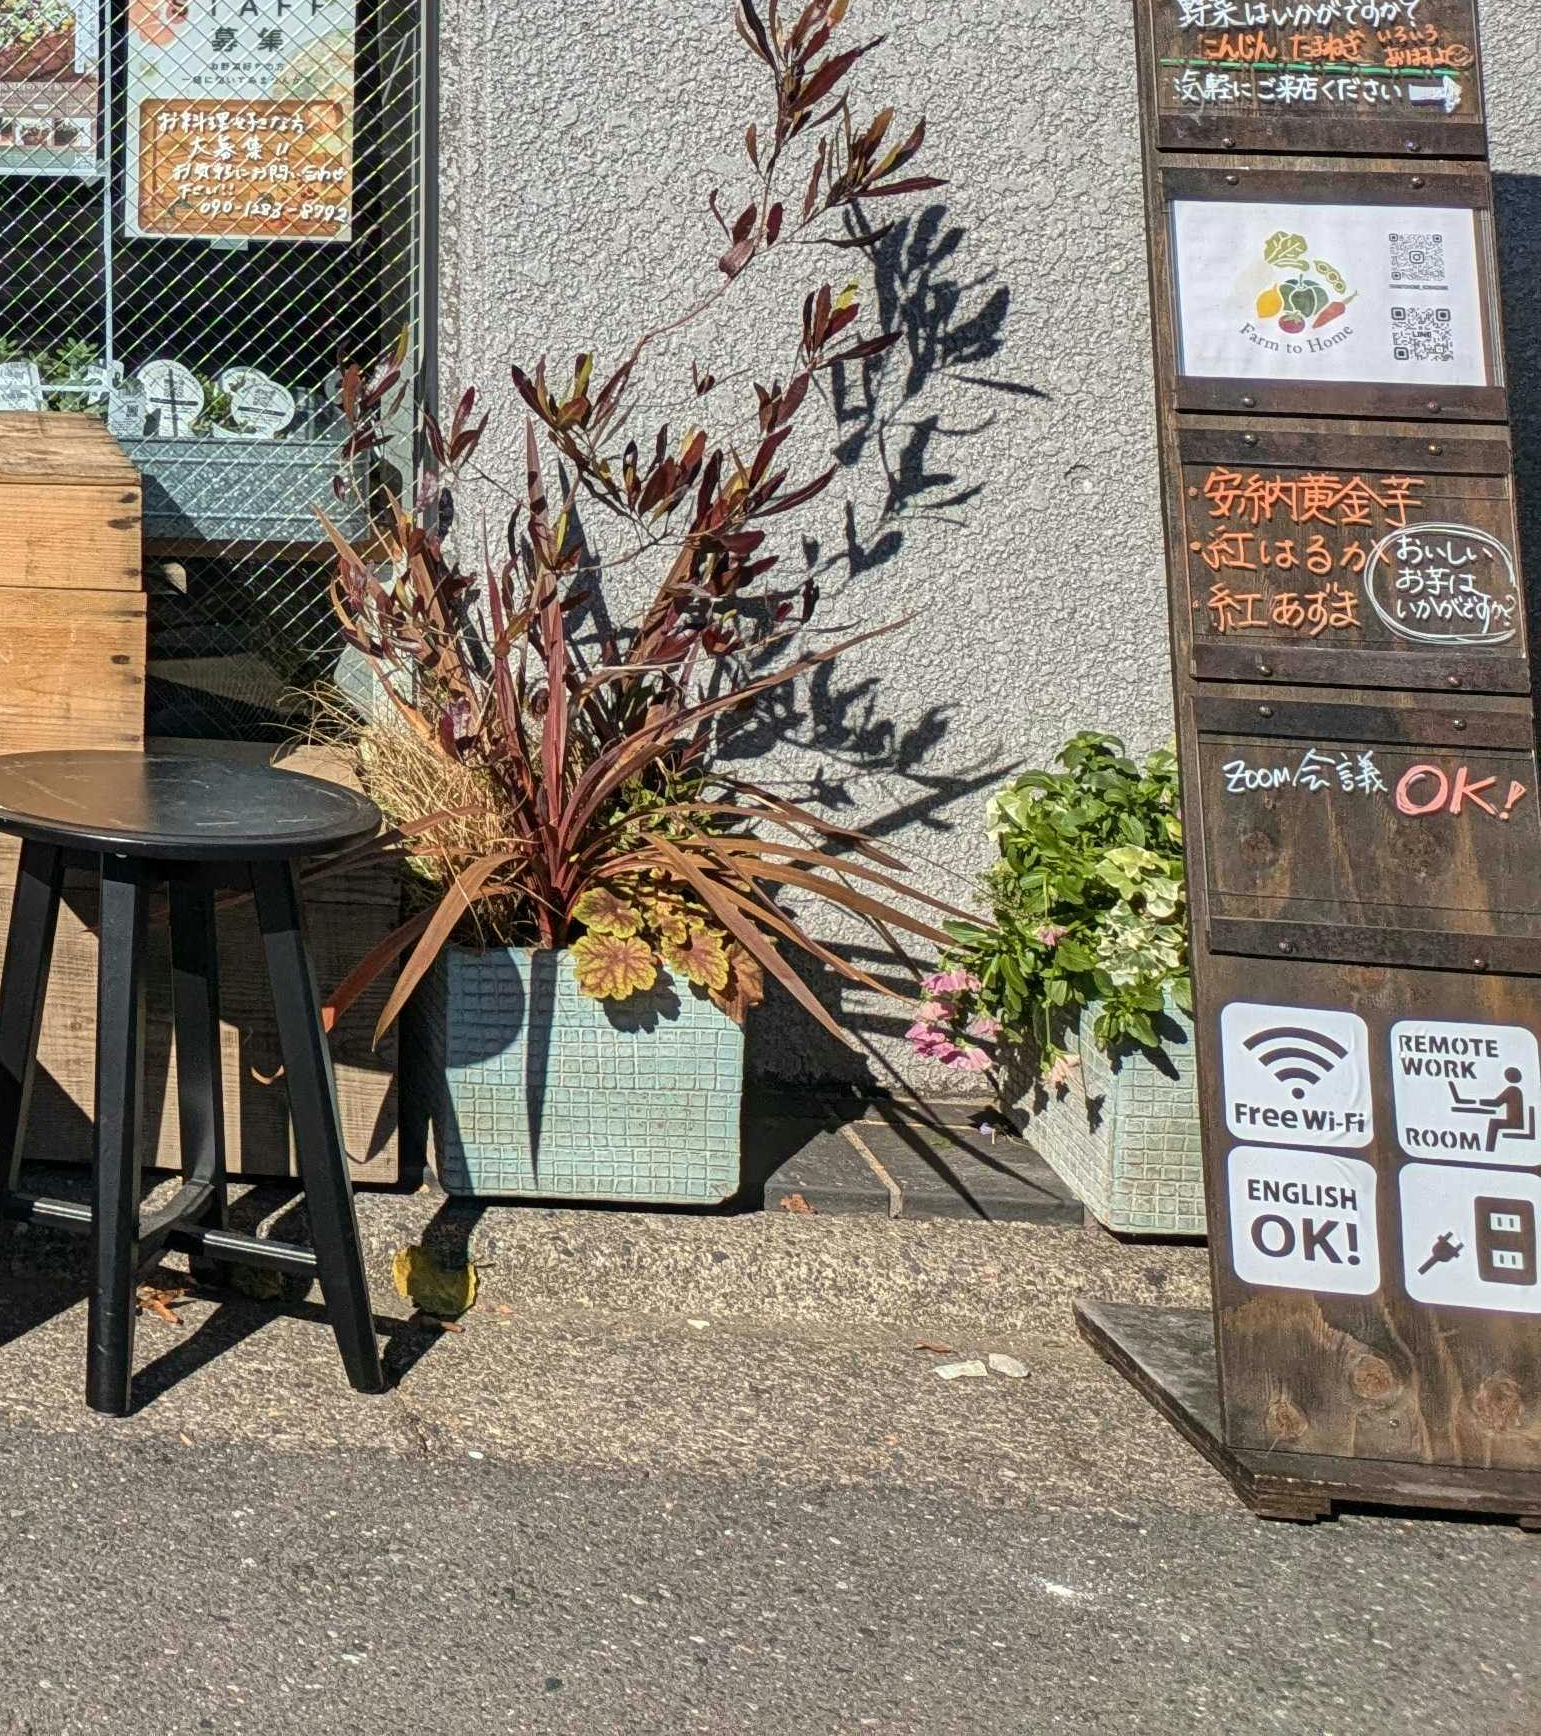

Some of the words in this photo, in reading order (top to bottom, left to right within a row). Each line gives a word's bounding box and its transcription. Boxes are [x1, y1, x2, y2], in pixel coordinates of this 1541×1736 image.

[212, 27, 285, 52] 募集
[1198, 31, 1278, 61] にんじん
[1289, 28, 1367, 61] たまねぎ
[1376, 24, 1438, 43] いろいろ
[158, 112, 305, 134] お料理好きな方
[1239, 321, 1280, 354] Farm
[1286, 342, 1304, 354] to
[1309, 324, 1355, 353] Home
[1201, 526, 1391, 574] 紅はるか
[1397, 533, 1493, 564] おいしい
[1396, 566, 1477, 595] お芋は
[1208, 582, 1362, 634] 紅あずま
[1396, 765, 1526, 820] OK!
[1398, 1035, 1499, 1058] REMOTE
[1400, 1057, 1477, 1080] WORK
[1234, 1103, 1298, 1130] Free
[1302, 1108, 1365, 1134] Wi-Fi
[1405, 1128, 1481, 1151] ROOM
[1247, 1180, 1357, 1211] ENGLISH
[1250, 1214, 1361, 1266] OK!
